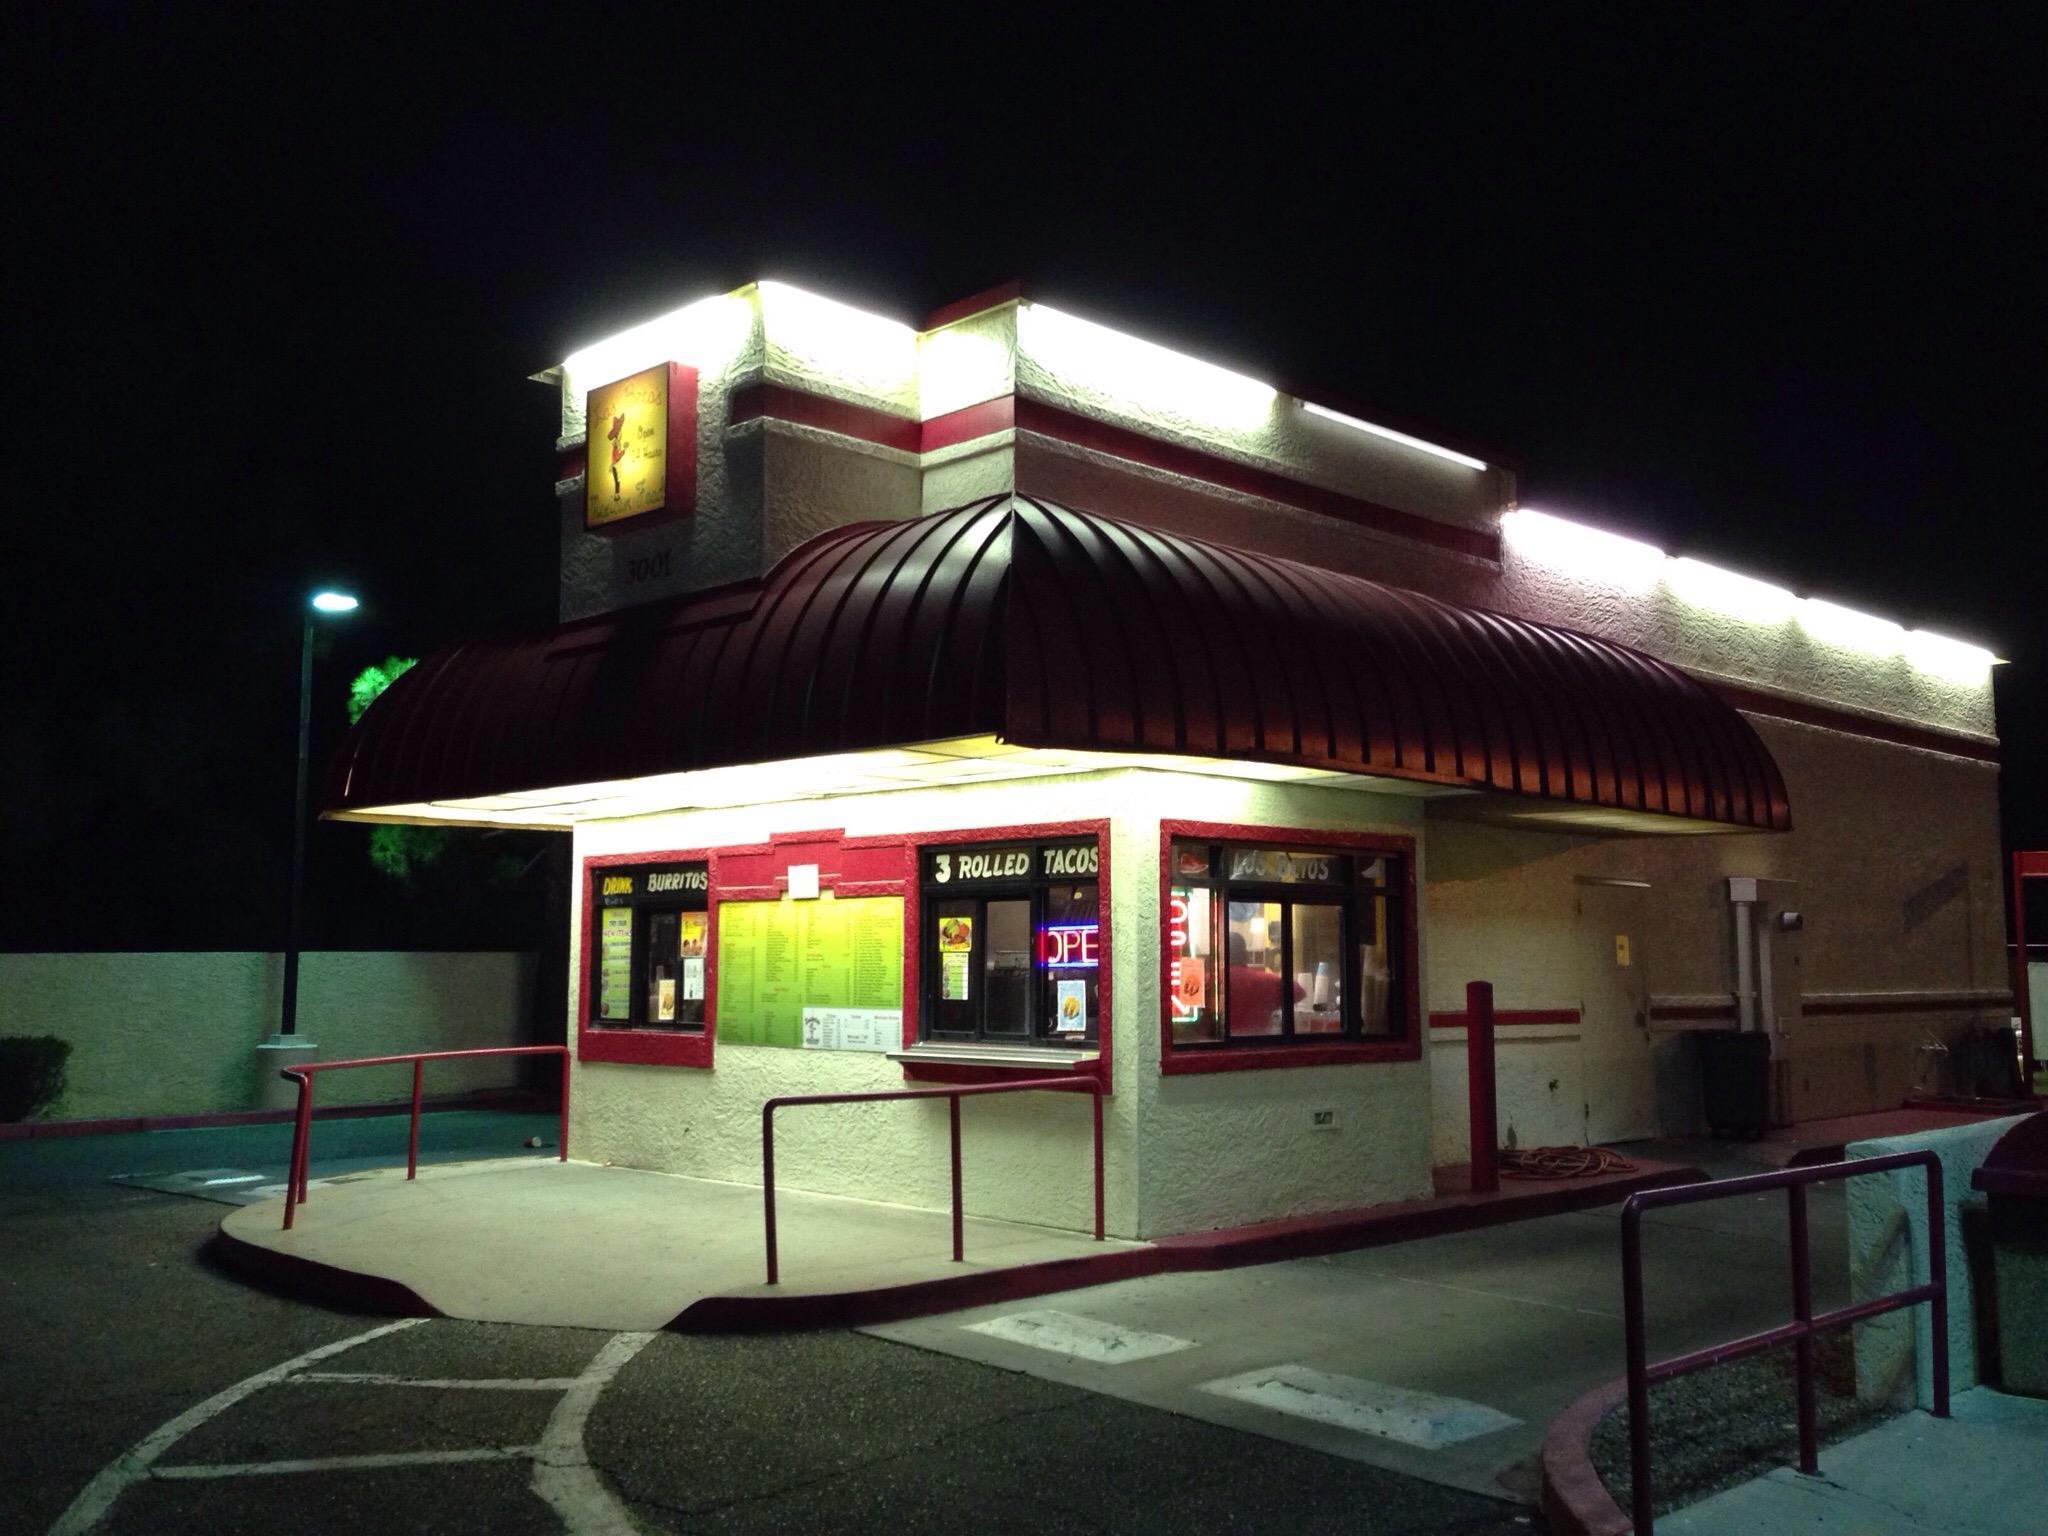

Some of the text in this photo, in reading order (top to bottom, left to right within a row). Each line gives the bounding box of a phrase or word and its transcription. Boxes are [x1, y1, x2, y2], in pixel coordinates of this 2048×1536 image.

[935, 846, 1099, 883] 3 ROLLED TACOS
[647, 871, 708, 892] BURRITOS
